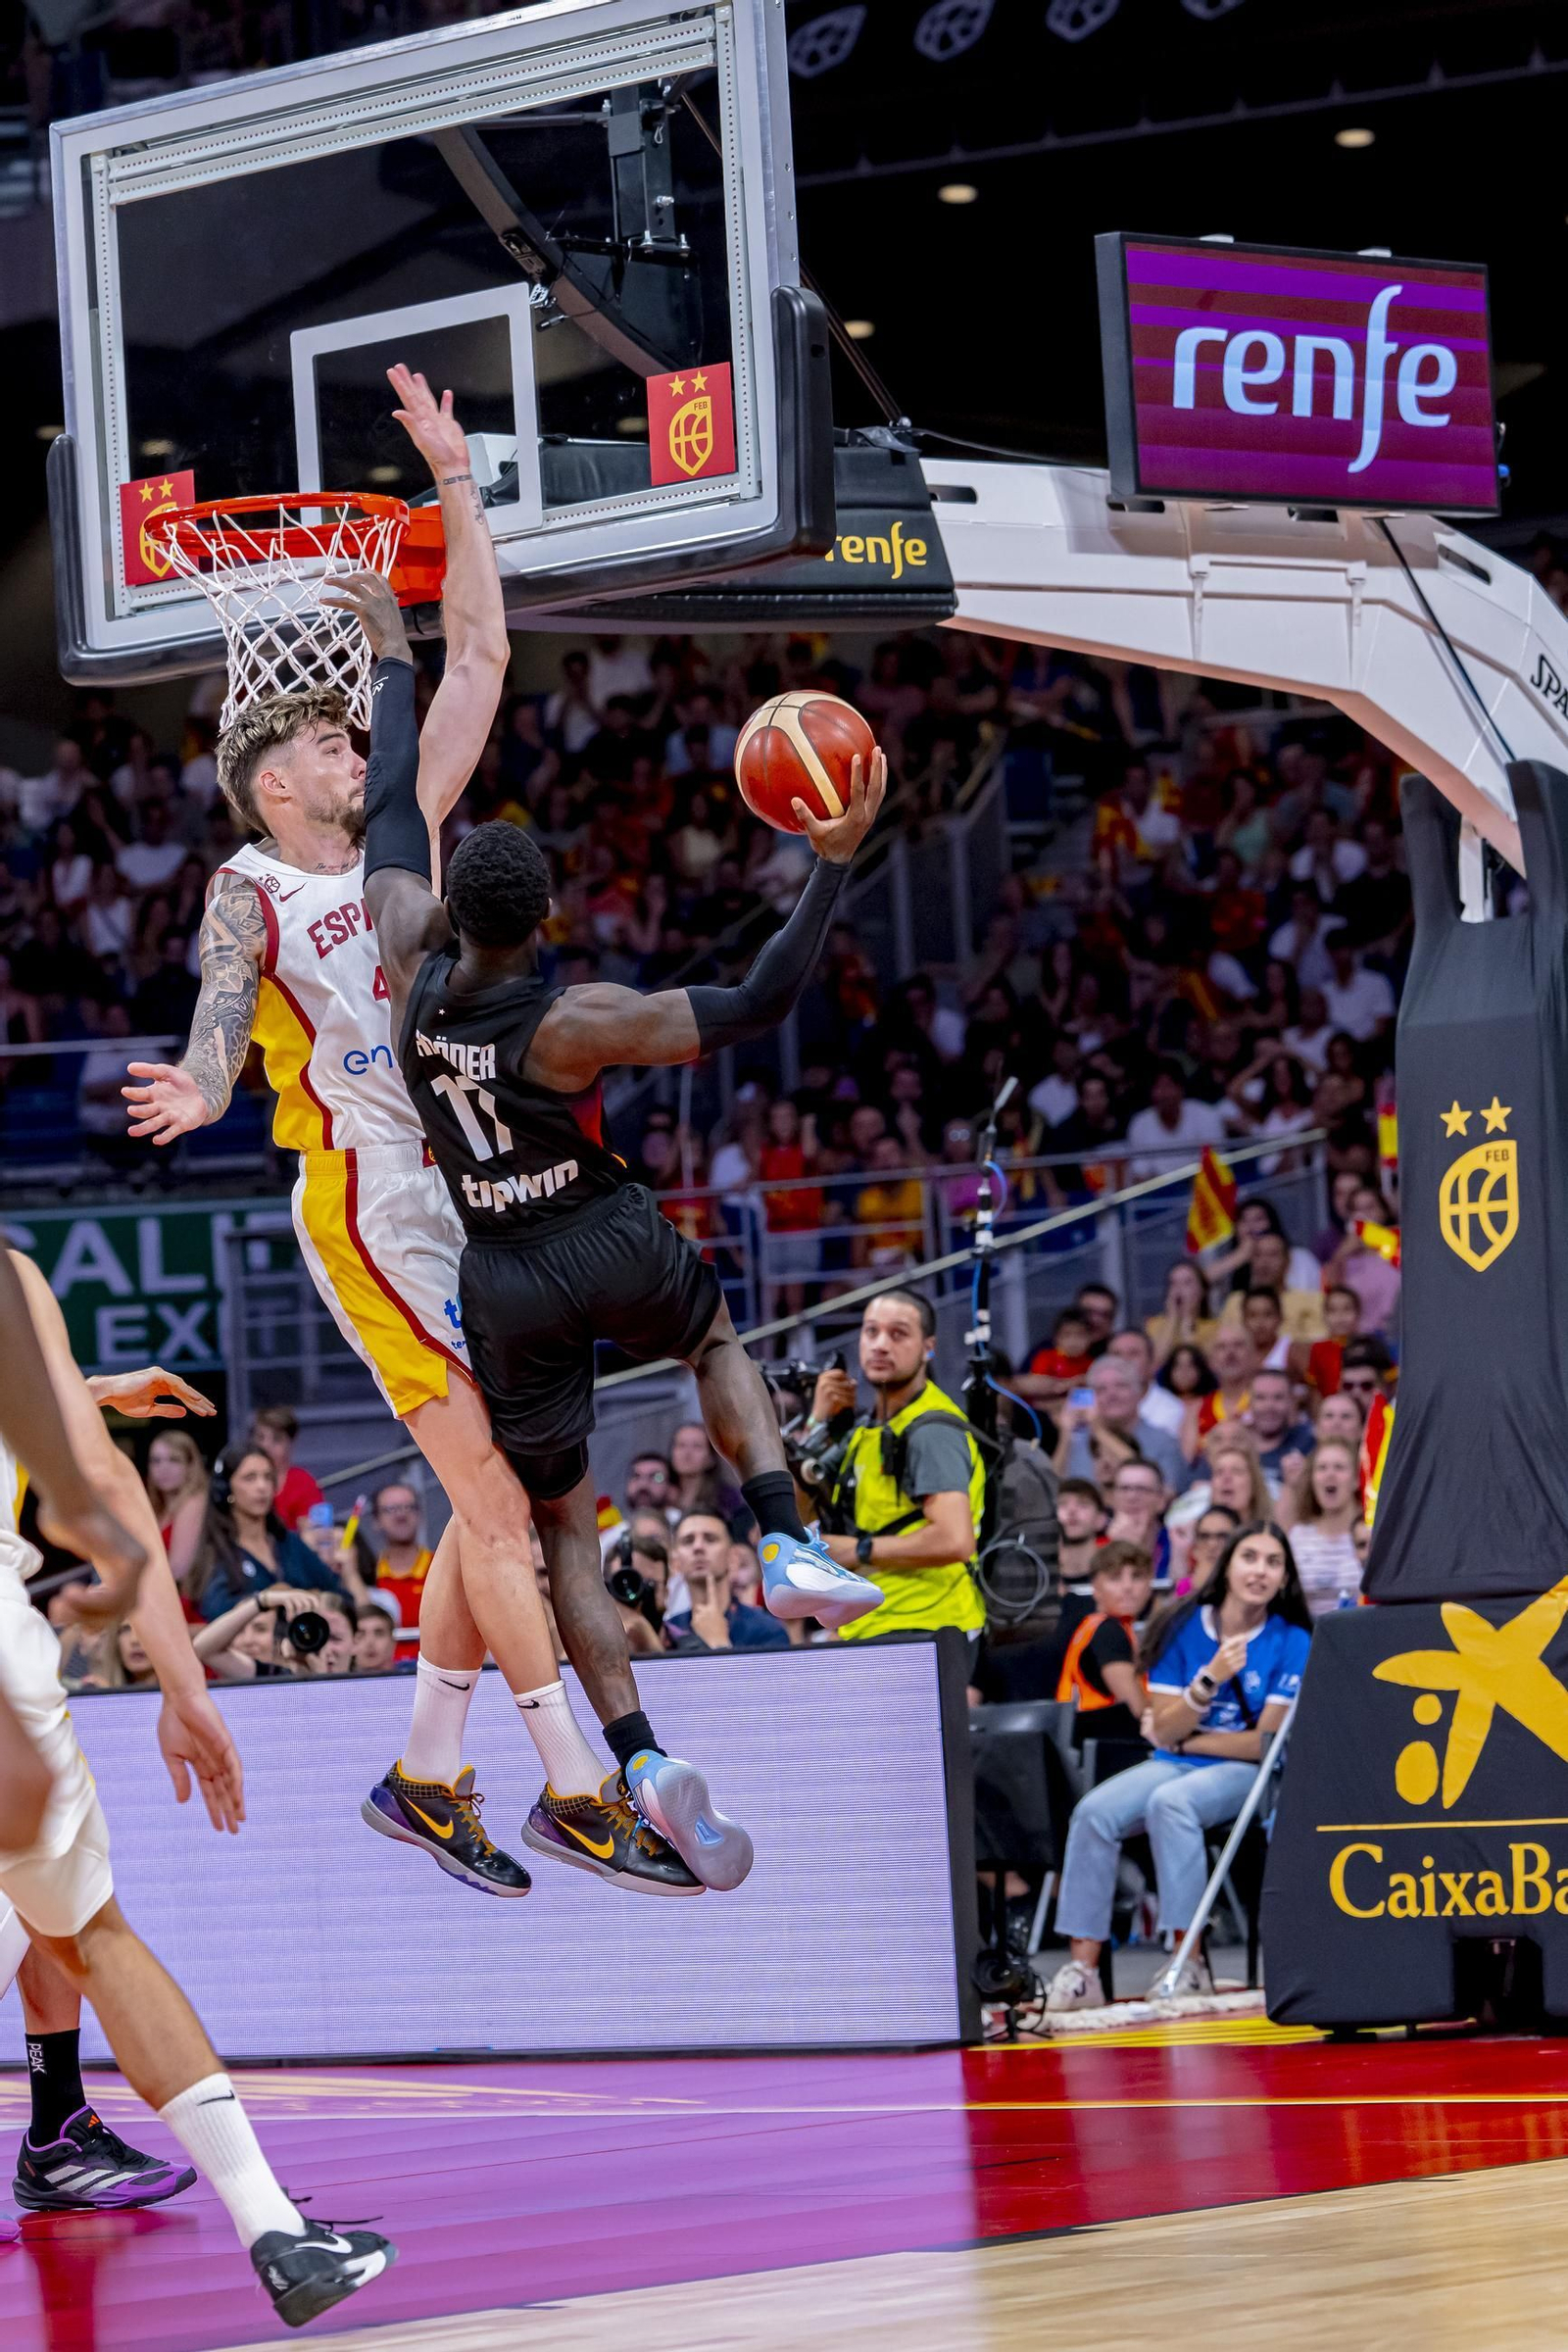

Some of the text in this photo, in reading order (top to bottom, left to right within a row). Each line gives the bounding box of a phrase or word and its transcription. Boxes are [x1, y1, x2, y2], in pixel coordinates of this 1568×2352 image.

[1173, 285, 1457, 472] renfe
[694, 401, 708, 411] FEB
[430, 1074, 514, 1161] 17
[1486, 1149, 1510, 1162] FEB
[462, 1159, 578, 1213] tipwin
[28, 2042, 46, 2074] PEAK
